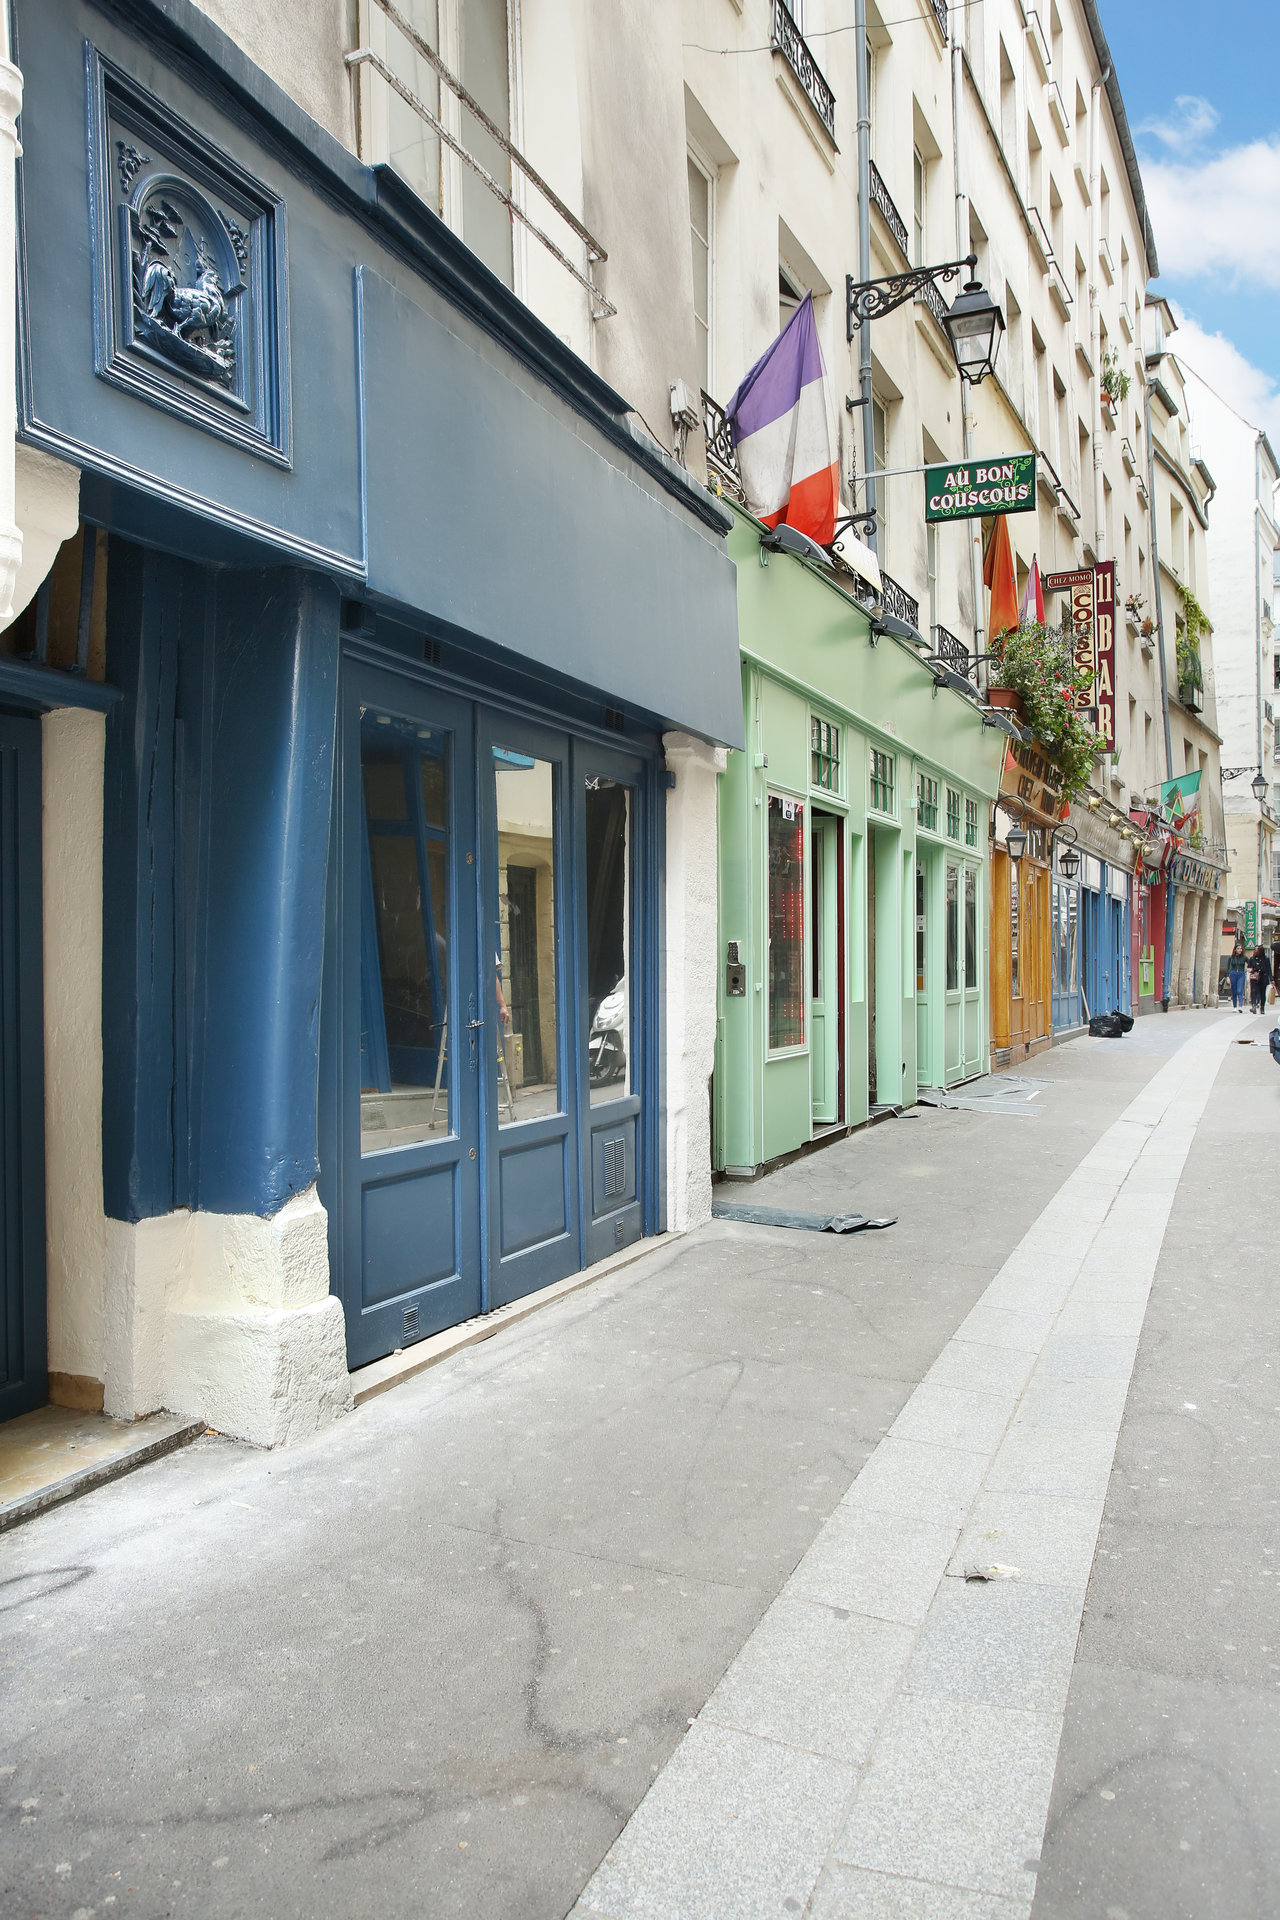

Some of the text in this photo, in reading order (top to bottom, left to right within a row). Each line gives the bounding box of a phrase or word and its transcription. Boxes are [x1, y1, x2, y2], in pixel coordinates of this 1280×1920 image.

[944, 464, 1014, 488] AU BON
[929, 483, 1029, 511] COUSCOUS
[1049, 573, 1091, 585] CHEZ MOMO
[1073, 593, 1093, 707] COUSCOS
[1097, 572, 1114, 741] 11 BAR
[1247, 903, 1255, 947] PIZZA
